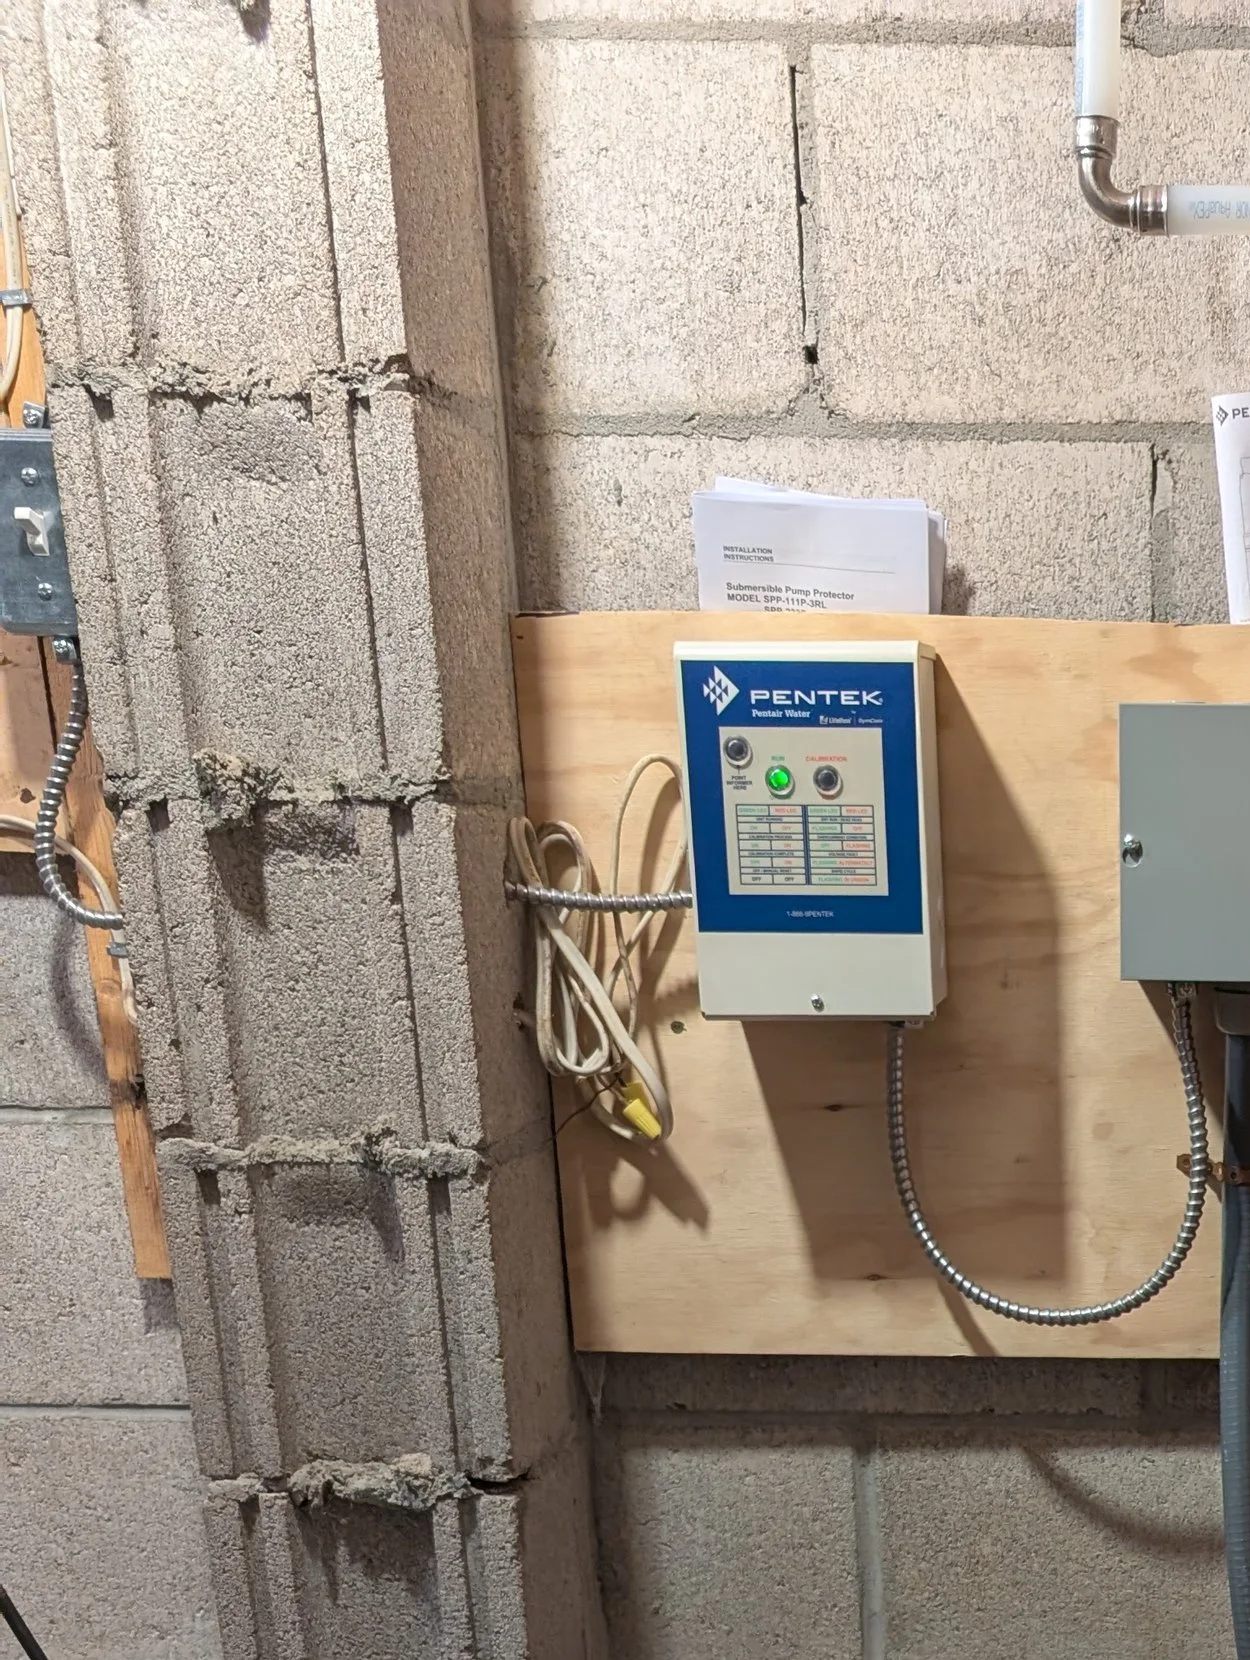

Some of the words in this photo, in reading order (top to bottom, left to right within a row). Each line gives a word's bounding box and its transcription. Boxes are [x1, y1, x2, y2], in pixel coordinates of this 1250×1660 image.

[723, 546, 772, 554] INSTALLATION
[724, 554, 774, 562] INSTRUCTIONS
[726, 582, 782, 593] Submersible
[785, 586, 811, 597] Pump
[813, 589, 854, 600] Protector
[727, 594, 760, 602] MODEL
[750, 690, 882, 706] PENTEK
[752, 709, 783, 718] Pentair
[785, 709, 810, 718] Water
